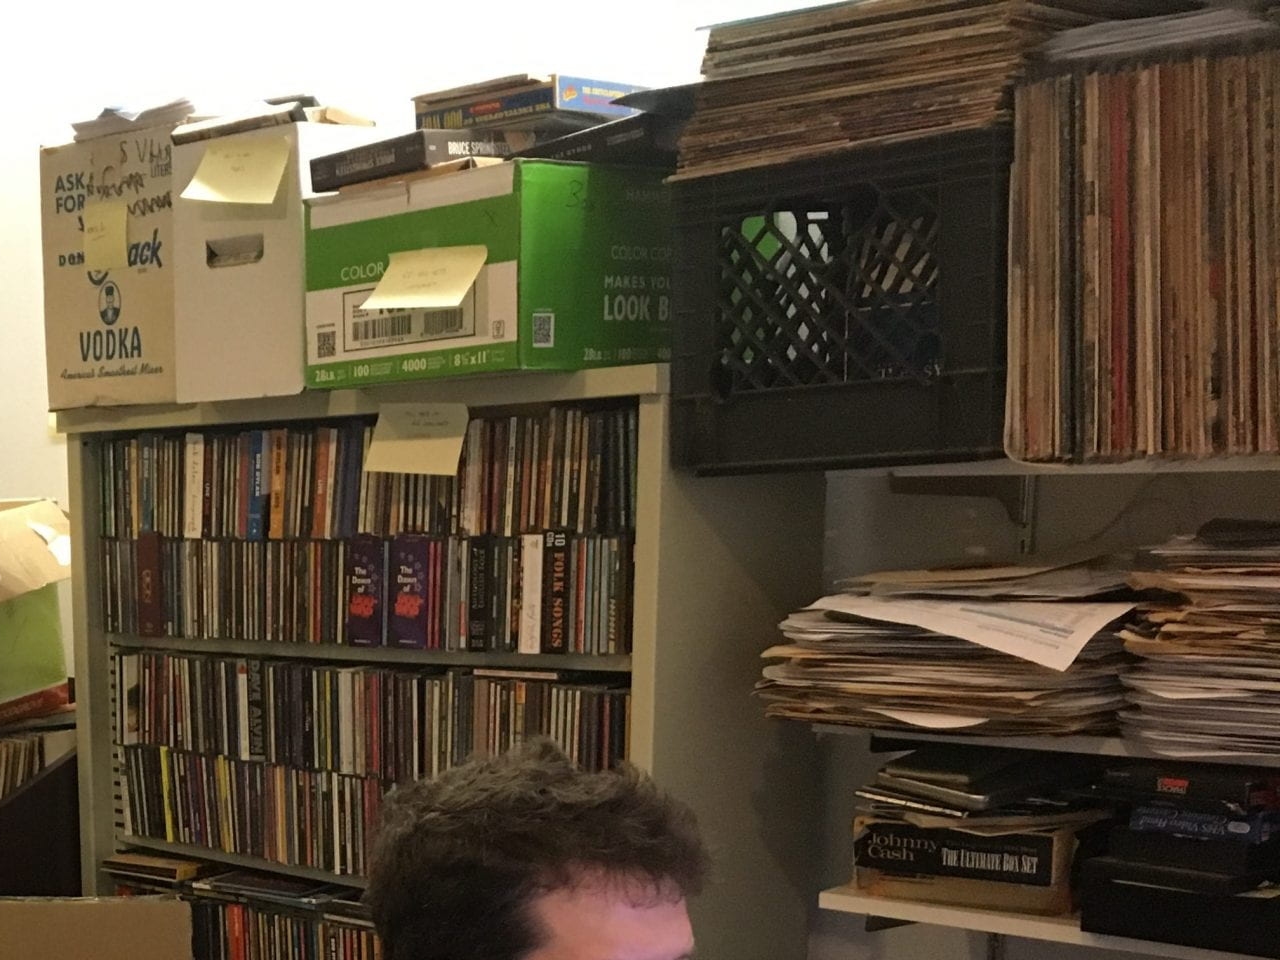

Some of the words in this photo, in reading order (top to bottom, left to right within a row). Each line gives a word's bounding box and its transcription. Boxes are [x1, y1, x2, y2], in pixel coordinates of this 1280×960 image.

[447, 141, 470, 155] BRUCE
[55, 171, 85, 194] ASK
[56, 194, 85, 214] FOR
[128, 228, 162, 267] ack
[341, 263, 385, 281] COLOR
[604, 275, 645, 289] MAKES
[604, 294, 651, 321] LOOK
[80, 326, 142, 362] VODKA
[402, 358, 437, 371] 4000
[545, 531, 553, 547] CDs
[554, 532, 566, 547] 10
[353, 566, 368, 576] The
[400, 565, 413, 575] The
[552, 552, 565, 594] FOLK
[357, 585, 366, 593] of
[403, 583, 412, 593] of
[551, 599, 564, 649] SONGS
[248, 659, 262, 700] DAVE
[250, 705, 265, 756] ALVIN
[867, 832, 938, 853] Johnny
[868, 845, 915, 861] Cash
[941, 847, 959, 868] THE
[960, 849, 1002, 871] ULTIMATE
[1003, 853, 1020, 873] BOX
[1021, 855, 1039, 874] SET
